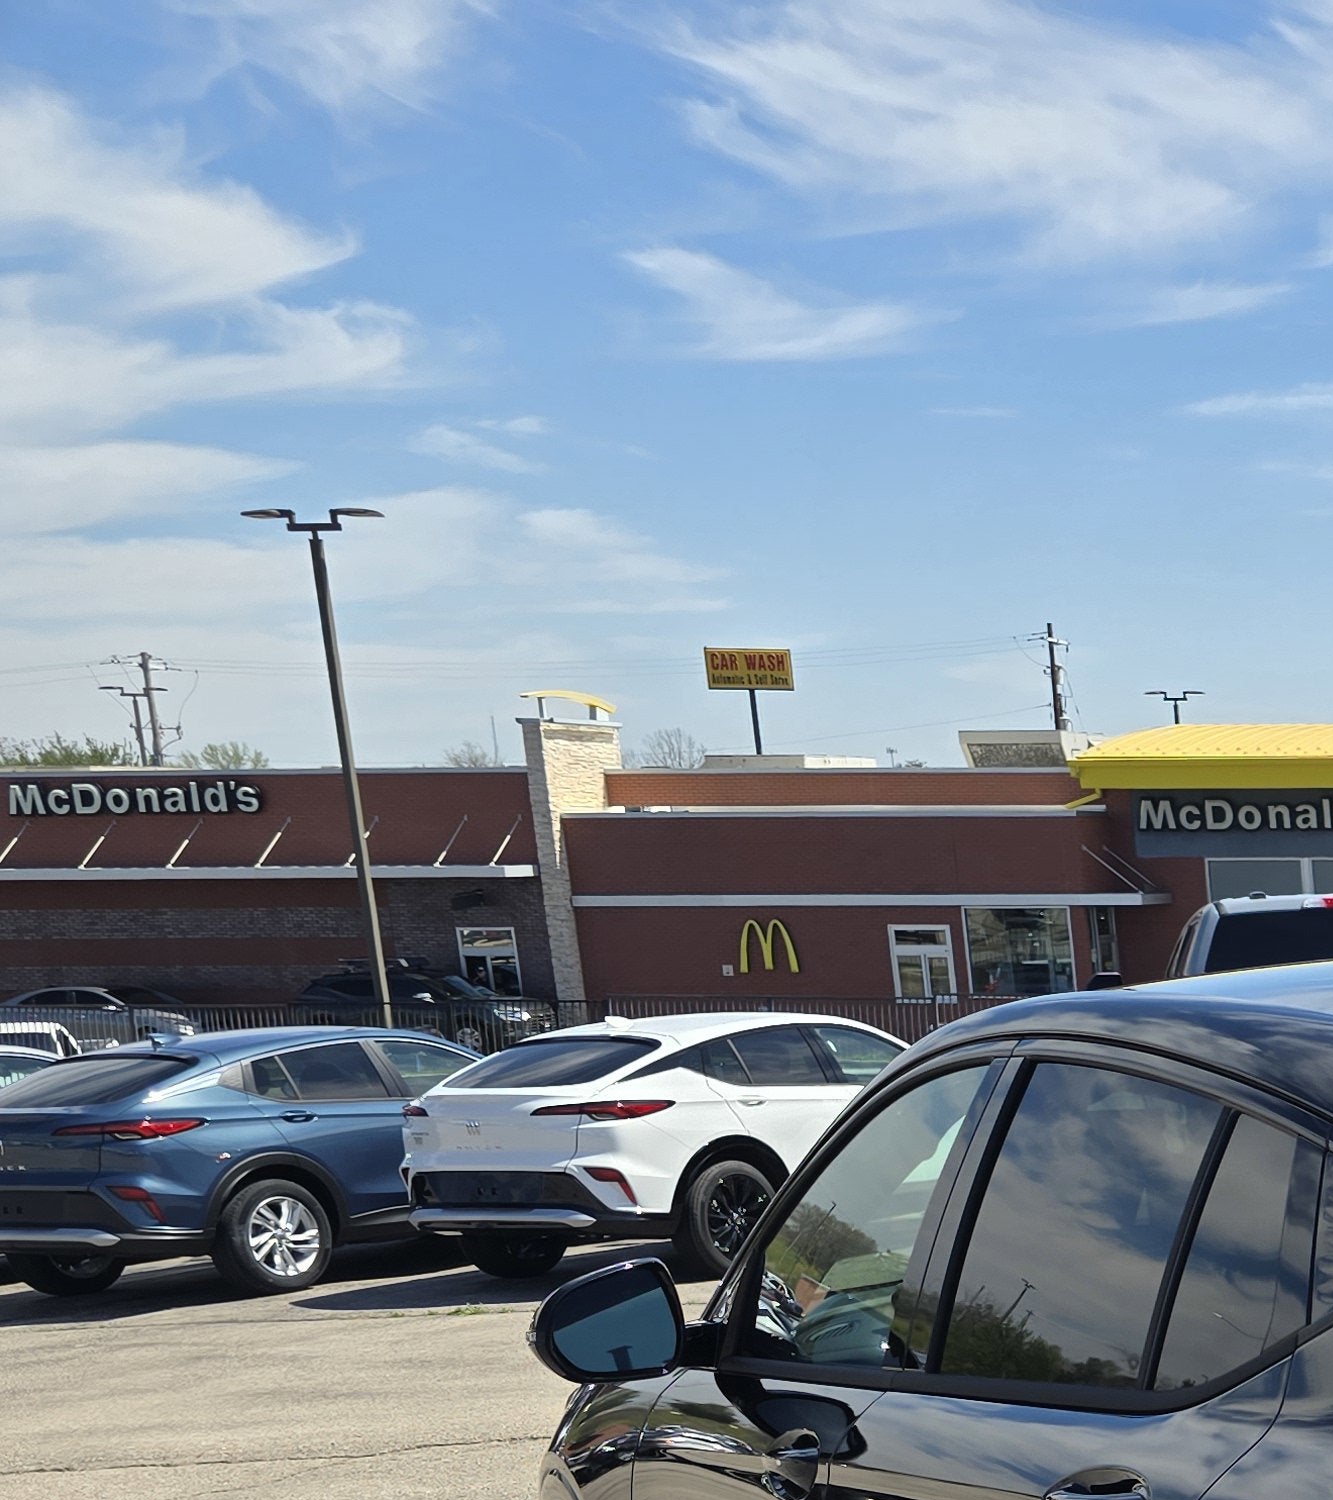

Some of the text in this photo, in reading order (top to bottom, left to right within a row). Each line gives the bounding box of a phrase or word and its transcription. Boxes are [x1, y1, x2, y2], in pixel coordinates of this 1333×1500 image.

[710, 653, 785, 671] CAR WASH
[9, 781, 260, 815] McDonald's
